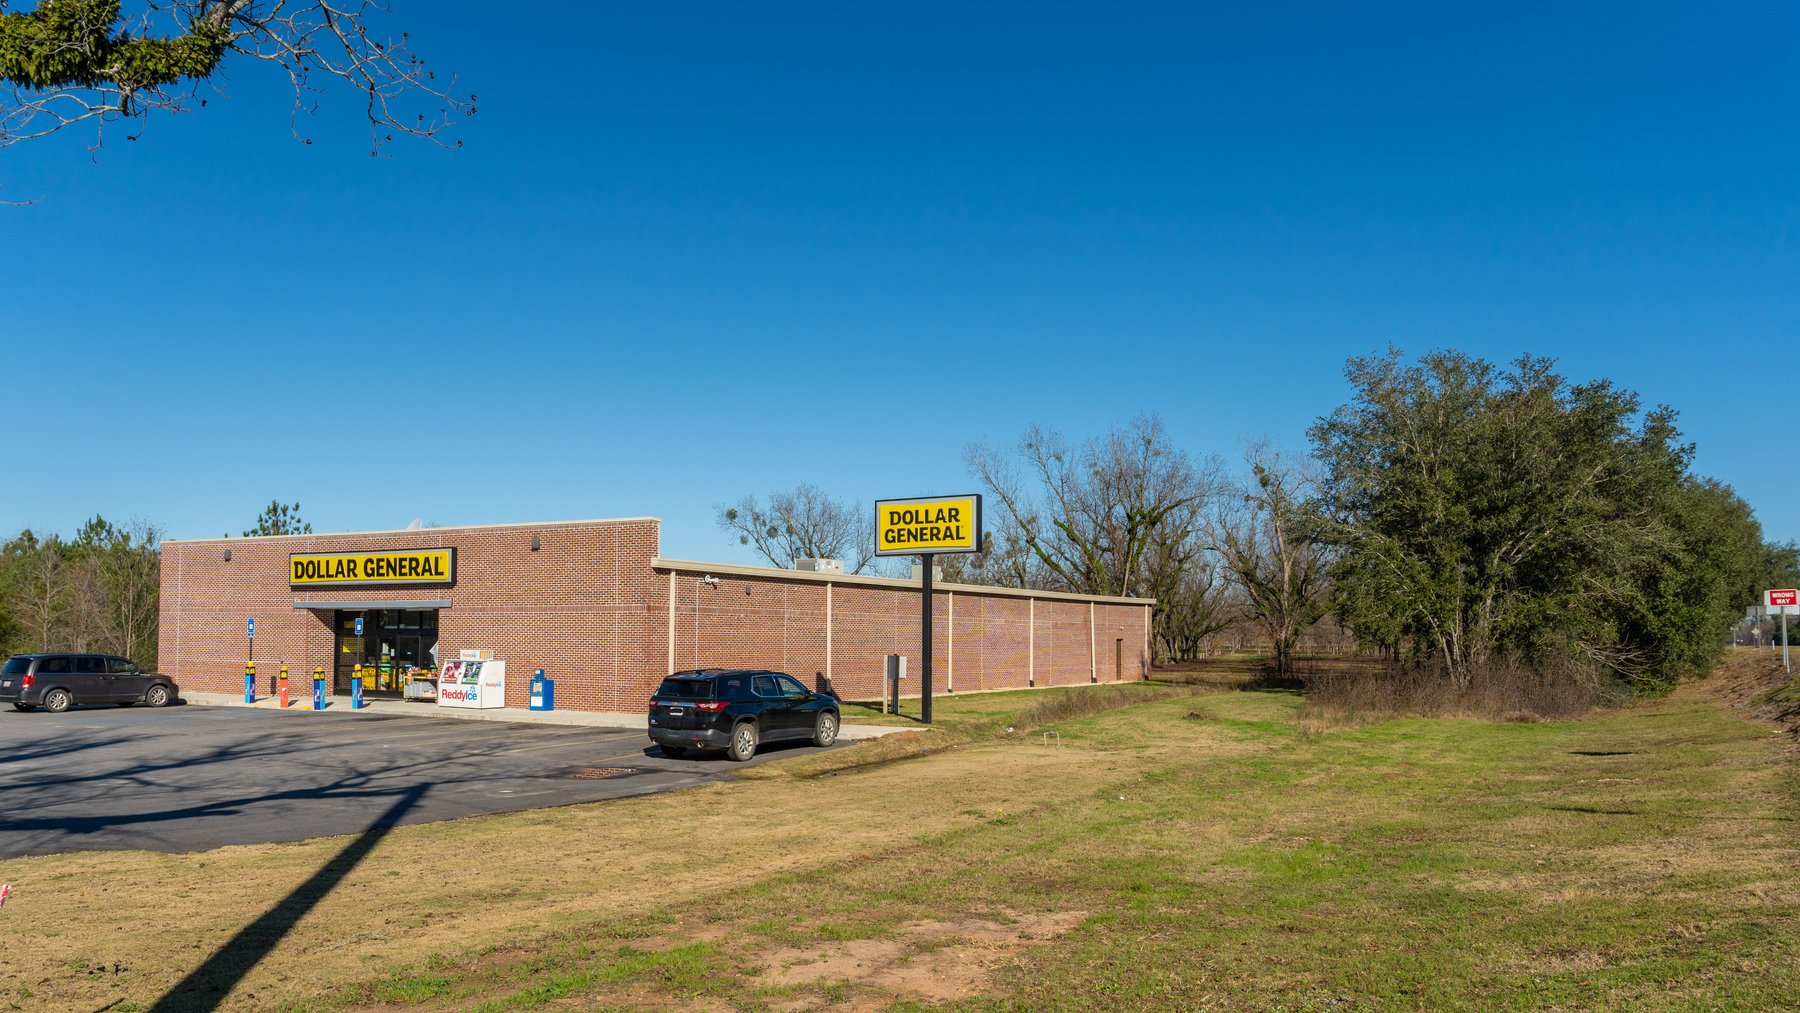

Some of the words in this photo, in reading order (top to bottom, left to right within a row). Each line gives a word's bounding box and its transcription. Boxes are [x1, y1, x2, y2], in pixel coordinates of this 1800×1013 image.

[890, 508, 960, 526] DOLLAR
[884, 525, 965, 544] GENERAL
[294, 559, 358, 580] DOLLAR
[364, 556, 444, 578] GENERAL
